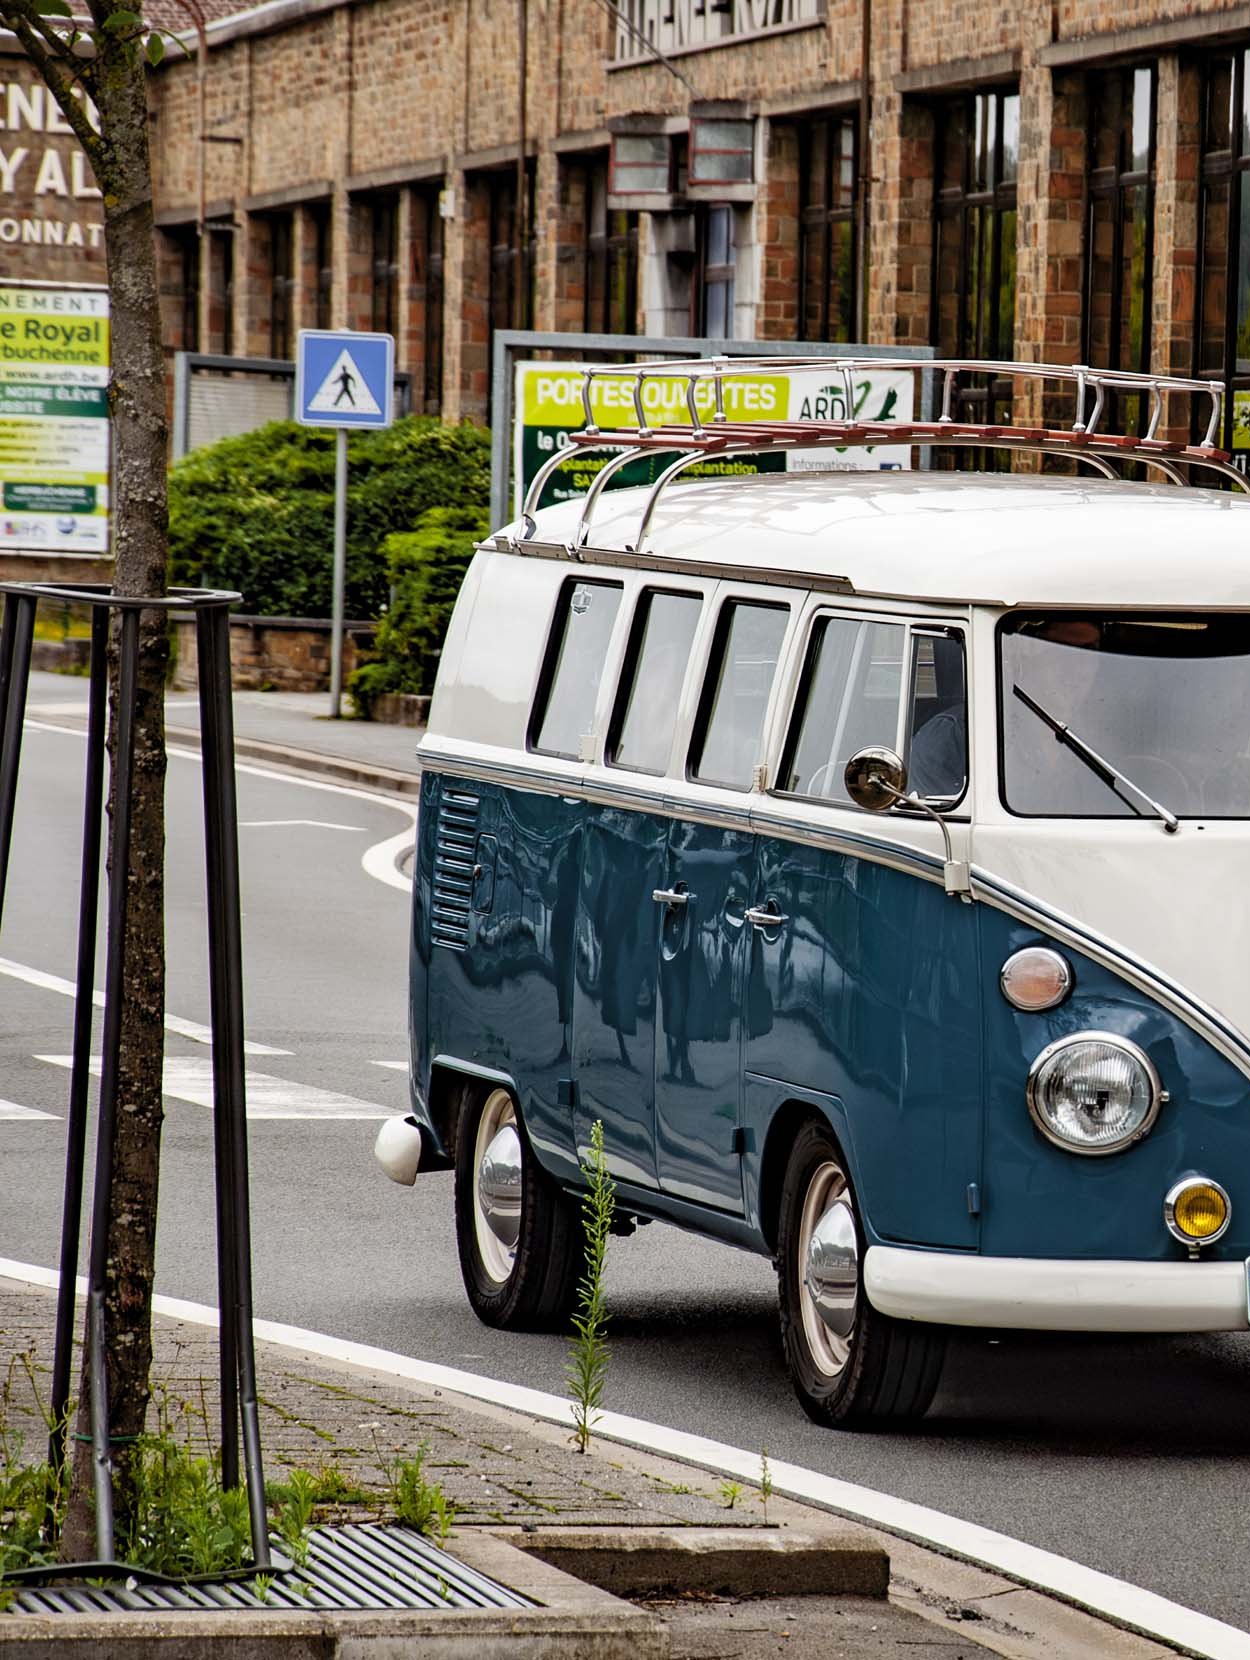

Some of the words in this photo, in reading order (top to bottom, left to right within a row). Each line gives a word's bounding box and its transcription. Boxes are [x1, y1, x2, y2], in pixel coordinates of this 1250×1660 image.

[0, 218, 104, 248] ONNAT
[25, 318, 99, 346] Royal
[536, 377, 634, 406] PORTES
[643, 380, 776, 410] OUVERTES
[537, 430, 554, 450] le
